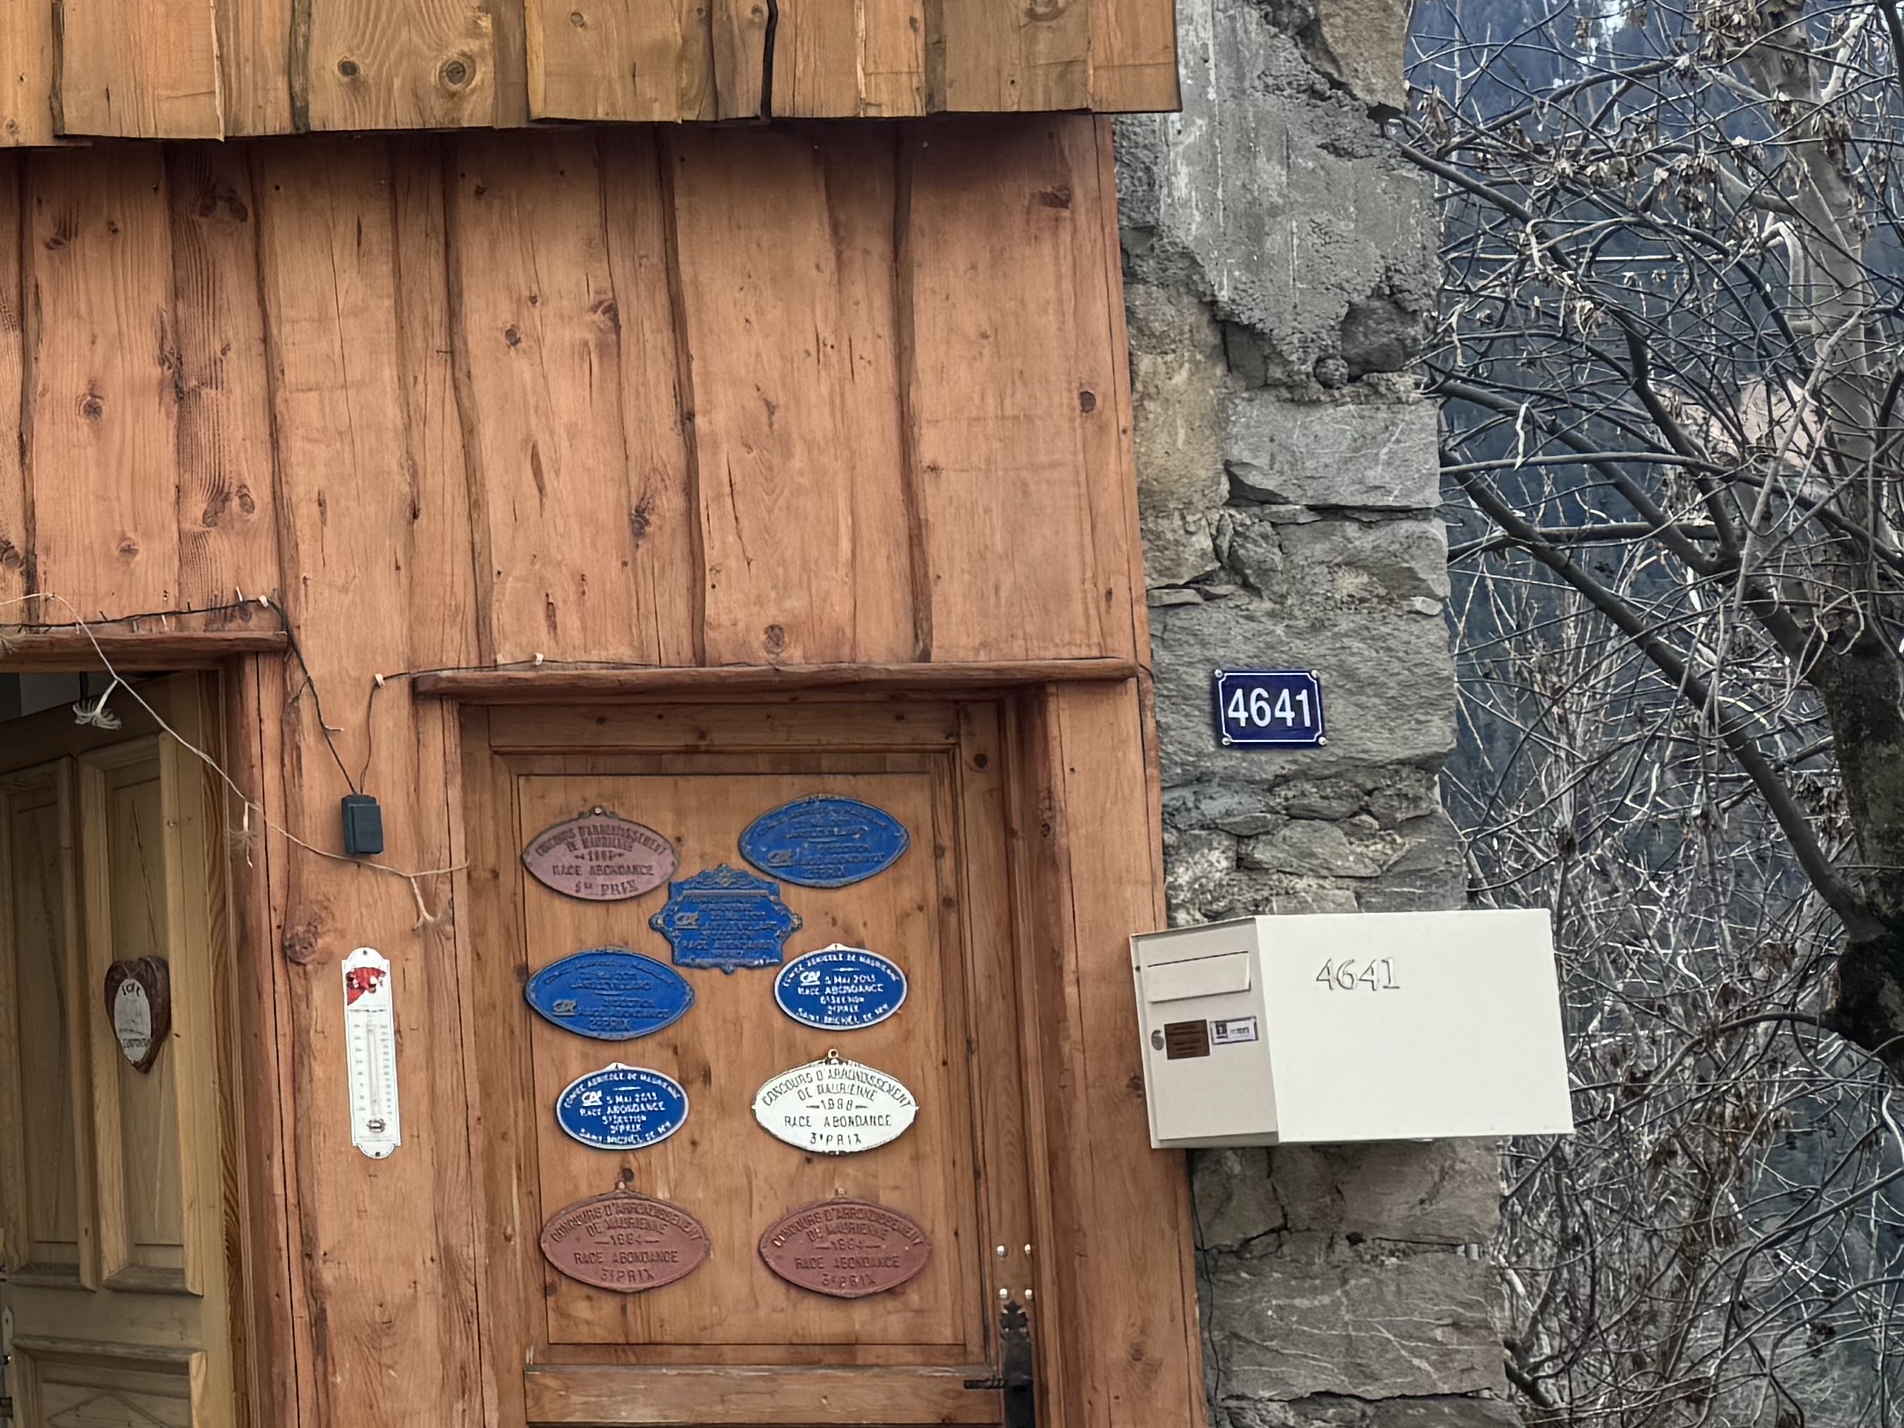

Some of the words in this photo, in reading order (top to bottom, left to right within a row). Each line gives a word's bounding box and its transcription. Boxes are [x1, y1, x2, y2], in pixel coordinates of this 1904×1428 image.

[1227, 687, 1313, 728] 4641
[1315, 956, 1401, 991] 4641
[761, 1072, 813, 1107] CONCOURS
[797, 1088, 811, 1101] DE
[817, 1083, 878, 1102] MAURIENNE
[784, 1115, 812, 1127] RACE
[823, 1114, 892, 1128] ABONDANCE
[573, 1252, 604, 1264] RACE
[611, 1251, 680, 1264] ABONDANCE
[795, 1257, 825, 1269] RACE
[832, 1256, 901, 1269] ABONDANCE
